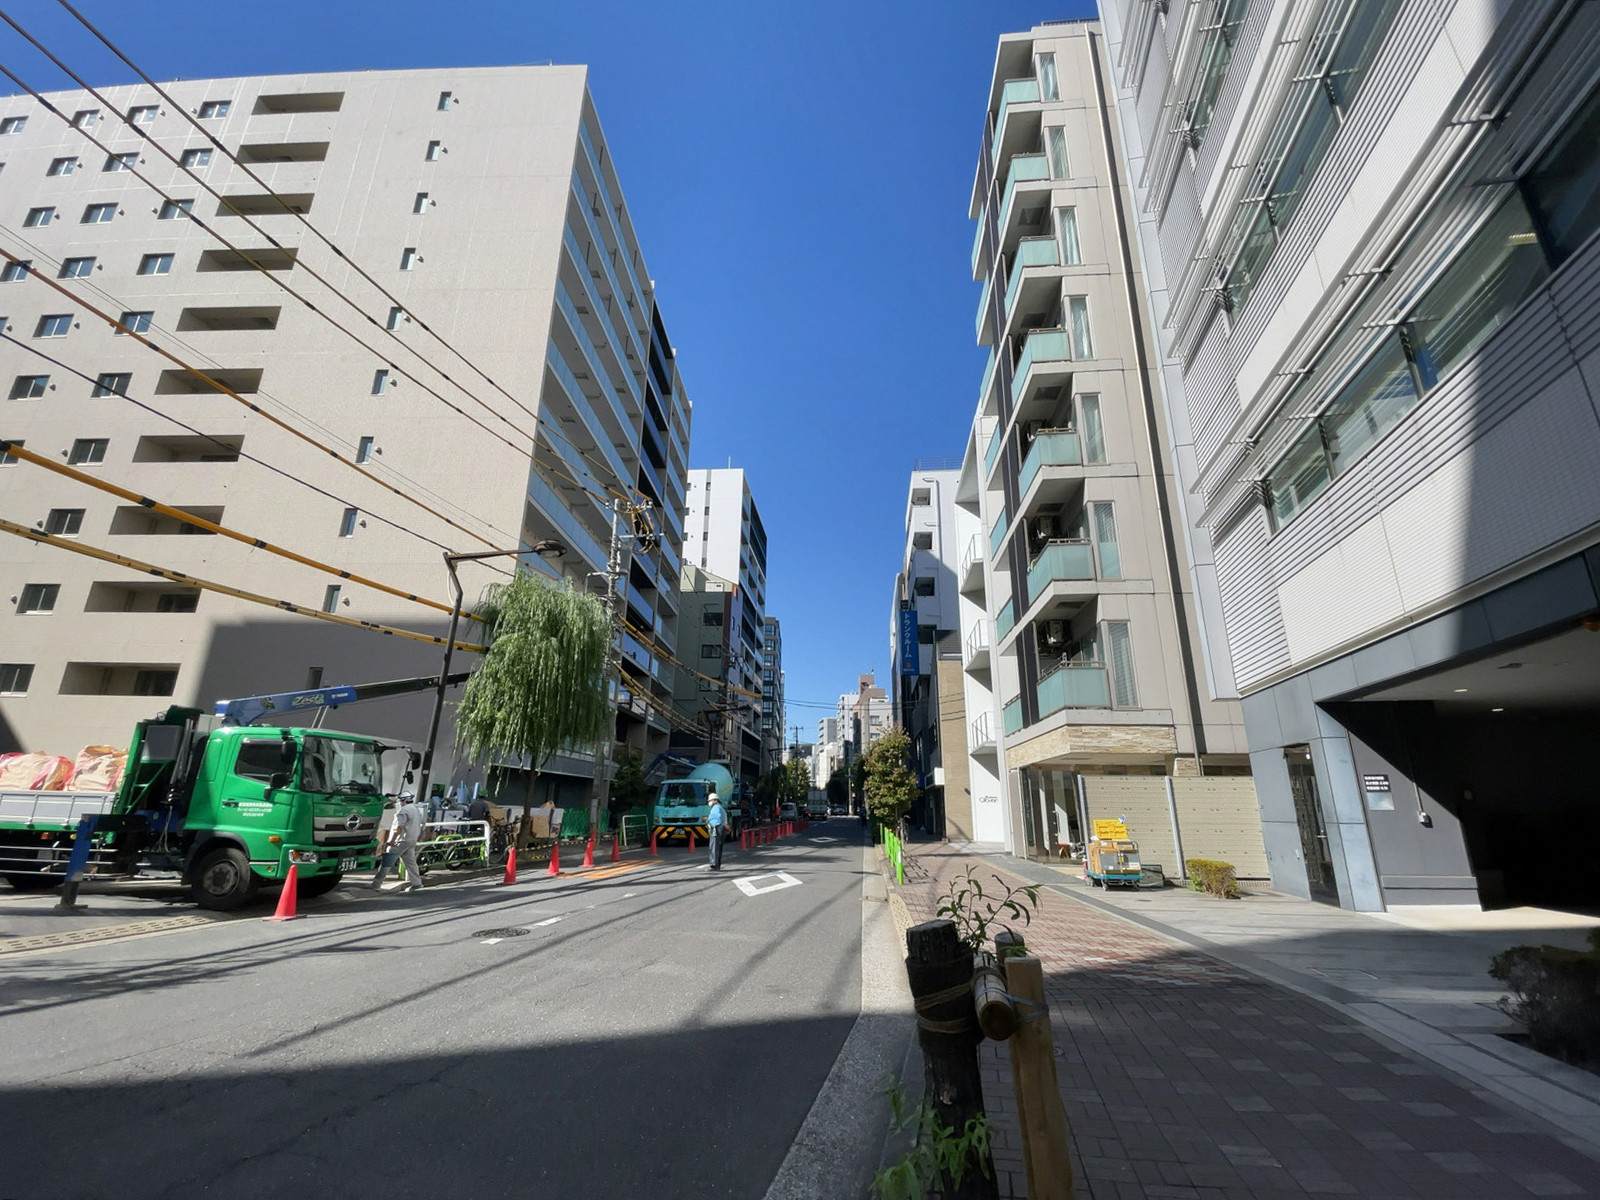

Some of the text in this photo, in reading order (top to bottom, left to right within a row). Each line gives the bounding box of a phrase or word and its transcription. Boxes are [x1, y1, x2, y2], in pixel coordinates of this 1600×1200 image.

[903, 612, 912, 658] トランクルーム
